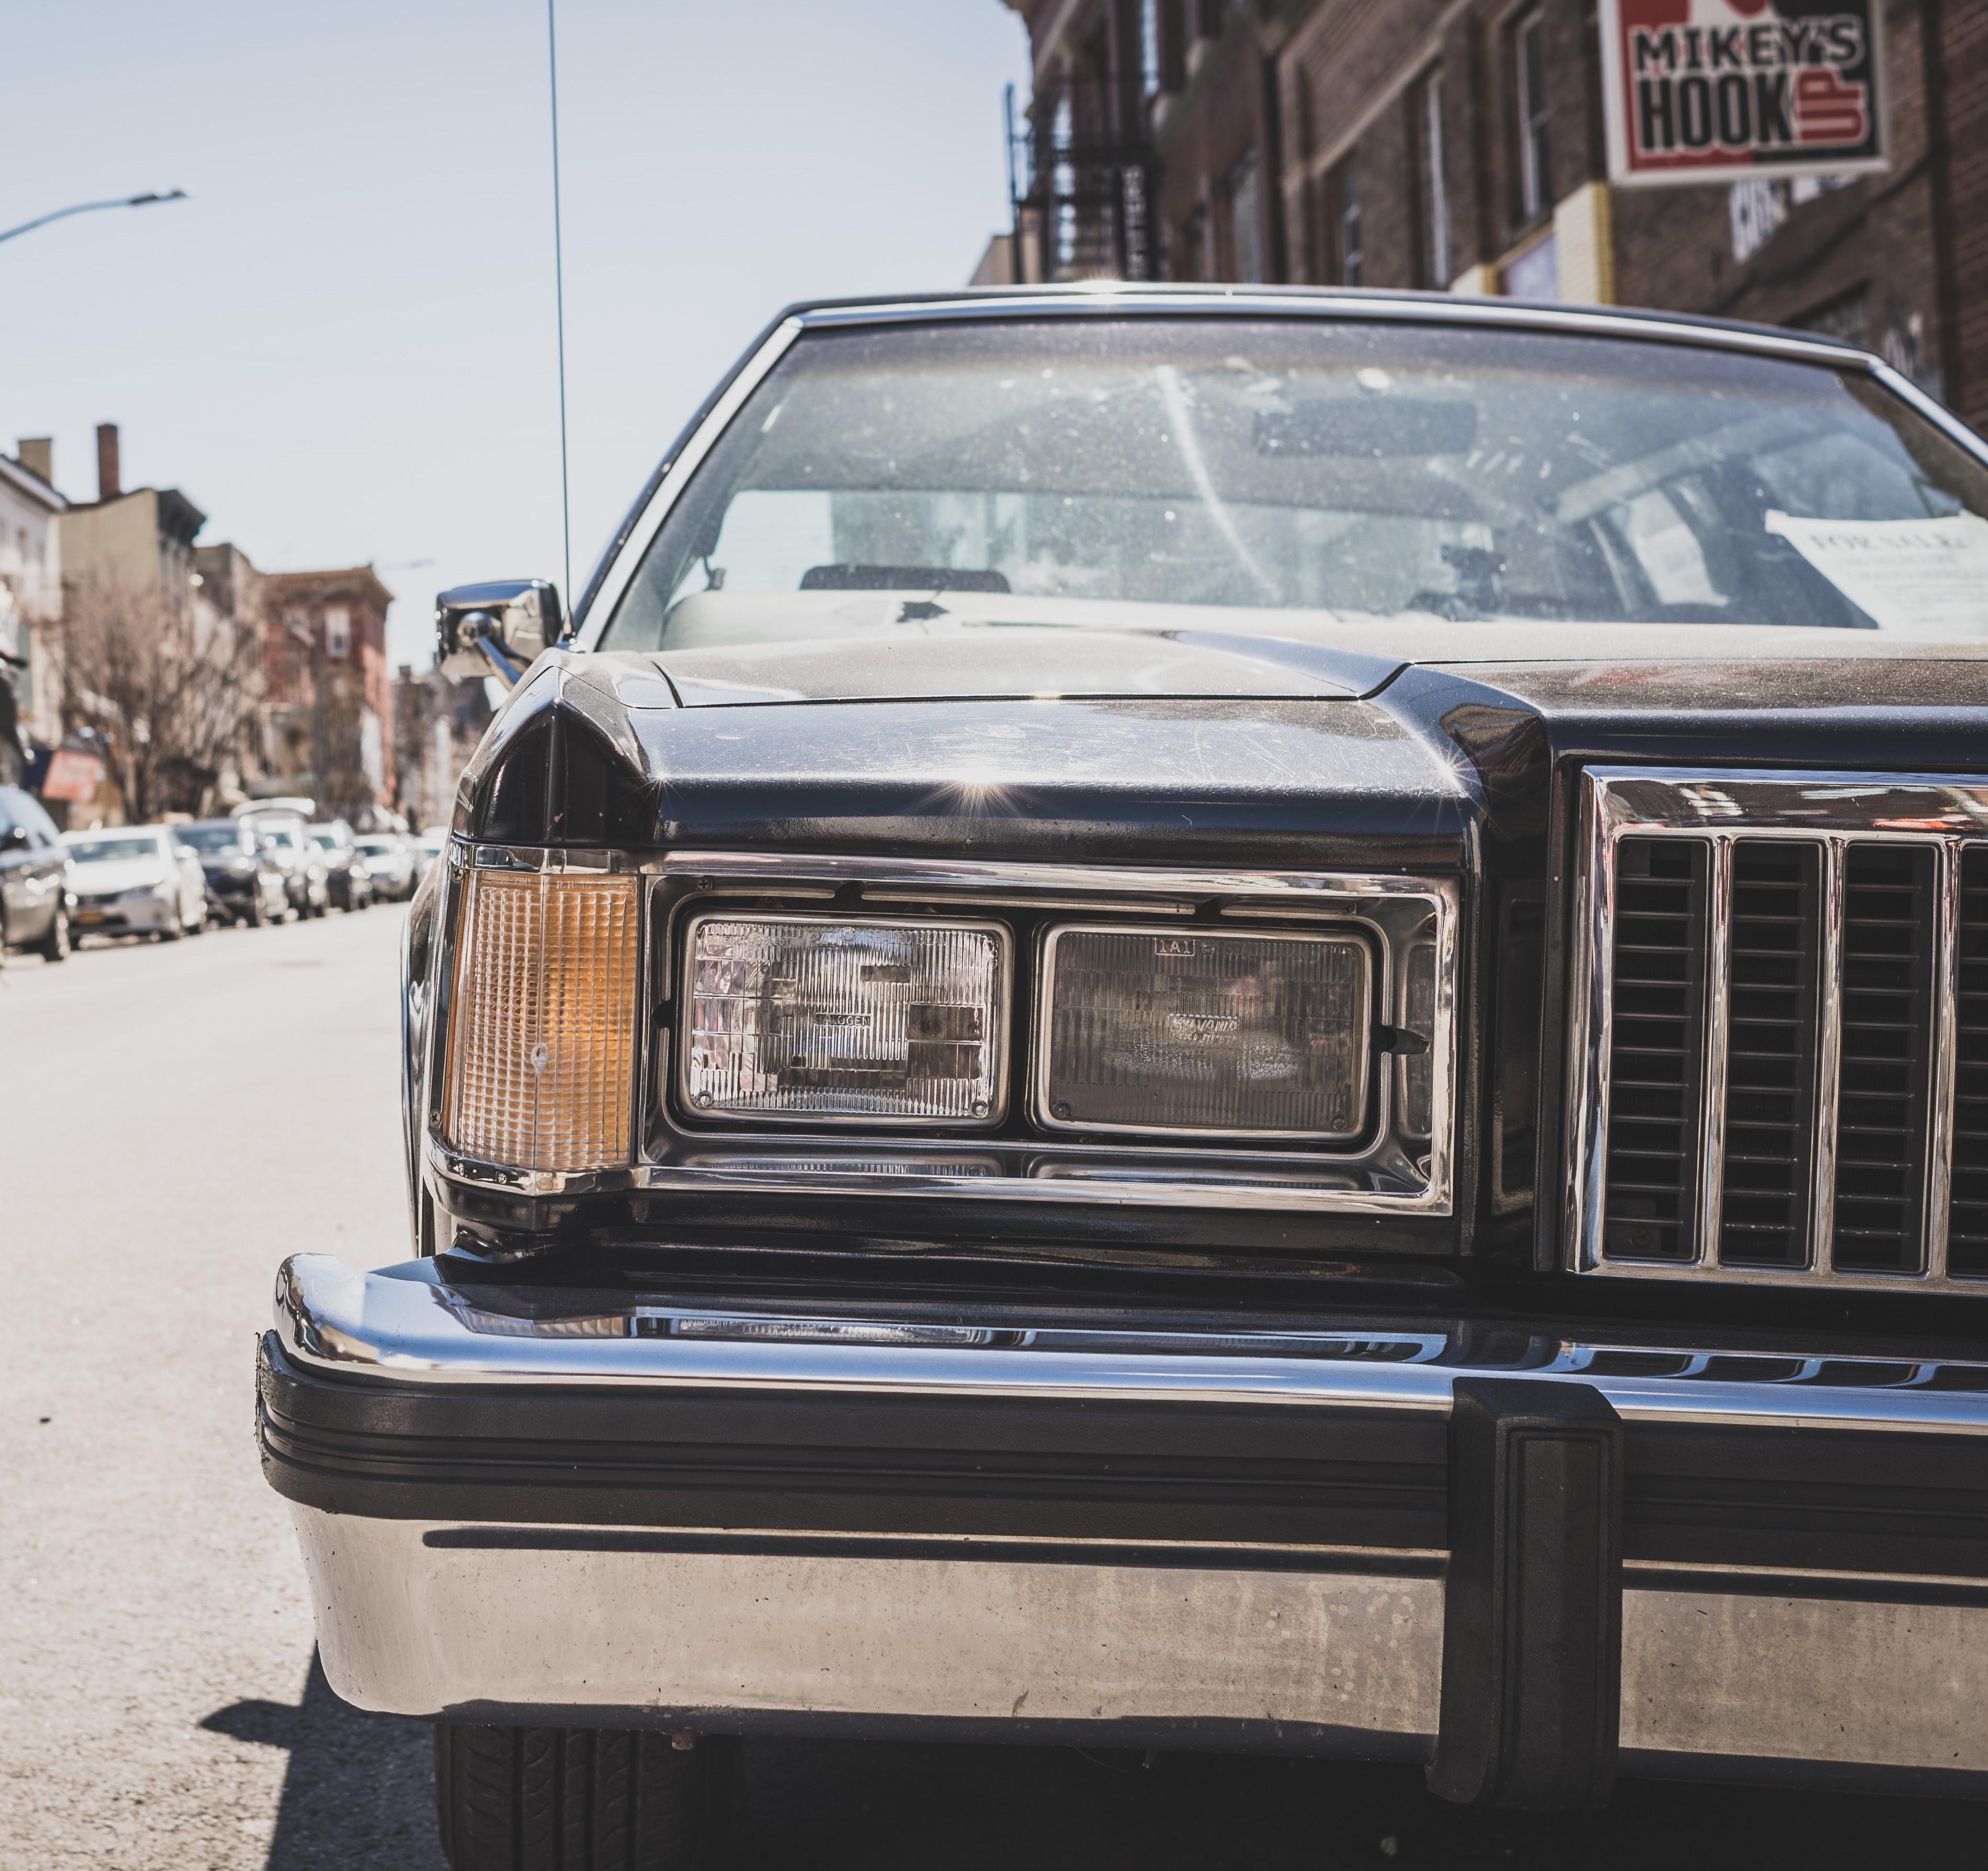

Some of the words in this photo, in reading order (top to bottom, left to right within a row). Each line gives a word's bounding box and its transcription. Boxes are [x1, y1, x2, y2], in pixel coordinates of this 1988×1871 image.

[1634, 19, 1859, 70] MIKEY'S
[1639, 71, 1793, 150] HOOK
[1798, 71, 1863, 141] UP
[1160, 939, 1190, 954] 1A1
[1172, 1017, 1237, 1031] SYLVANIA
